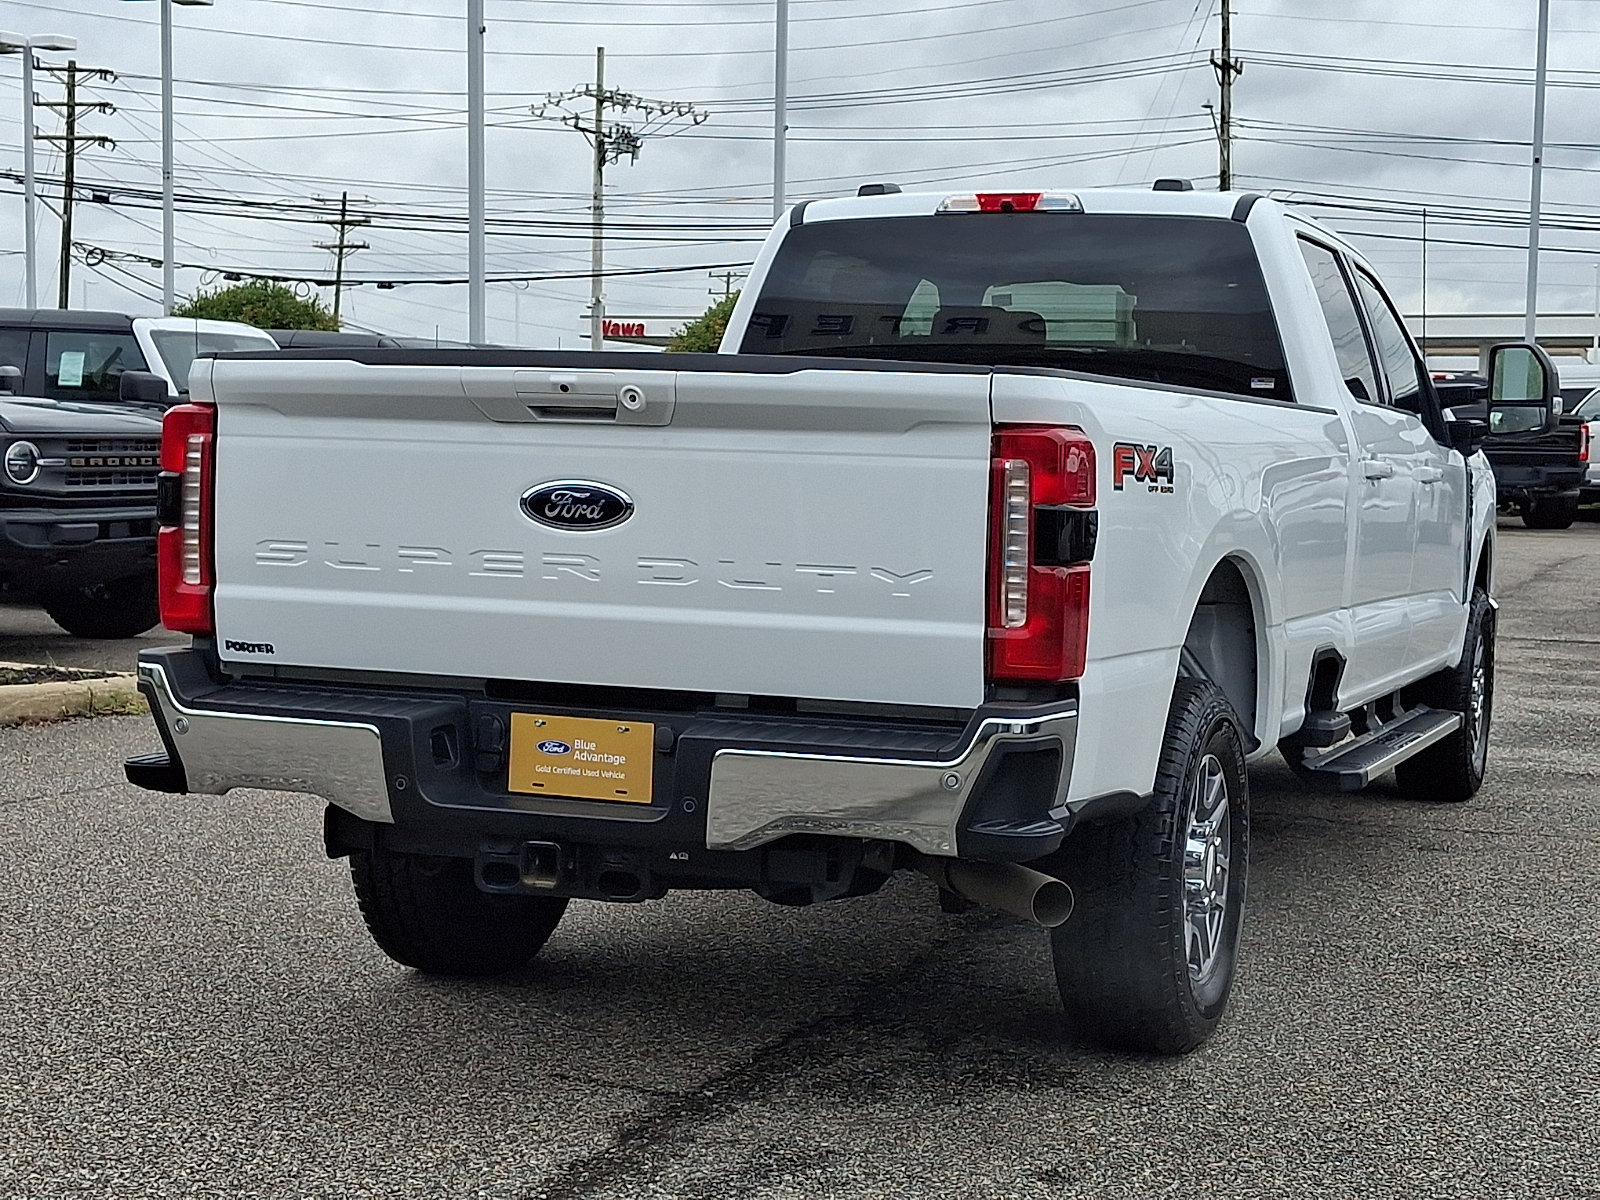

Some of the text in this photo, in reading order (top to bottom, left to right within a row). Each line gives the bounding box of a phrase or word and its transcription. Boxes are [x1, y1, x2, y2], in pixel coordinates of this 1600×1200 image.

[1113, 442, 1174, 491] FX4
[544, 490, 606, 519] Ford
[256, 539, 934, 597] SUPER DUTY
[224, 639, 275, 654] PORTER
[542, 742, 565, 753] Ford
[574, 739, 597, 750] Blue
[573, 750, 626, 765] Advantage
[535, 765, 626, 779] Gold Certified Used Vehicle
